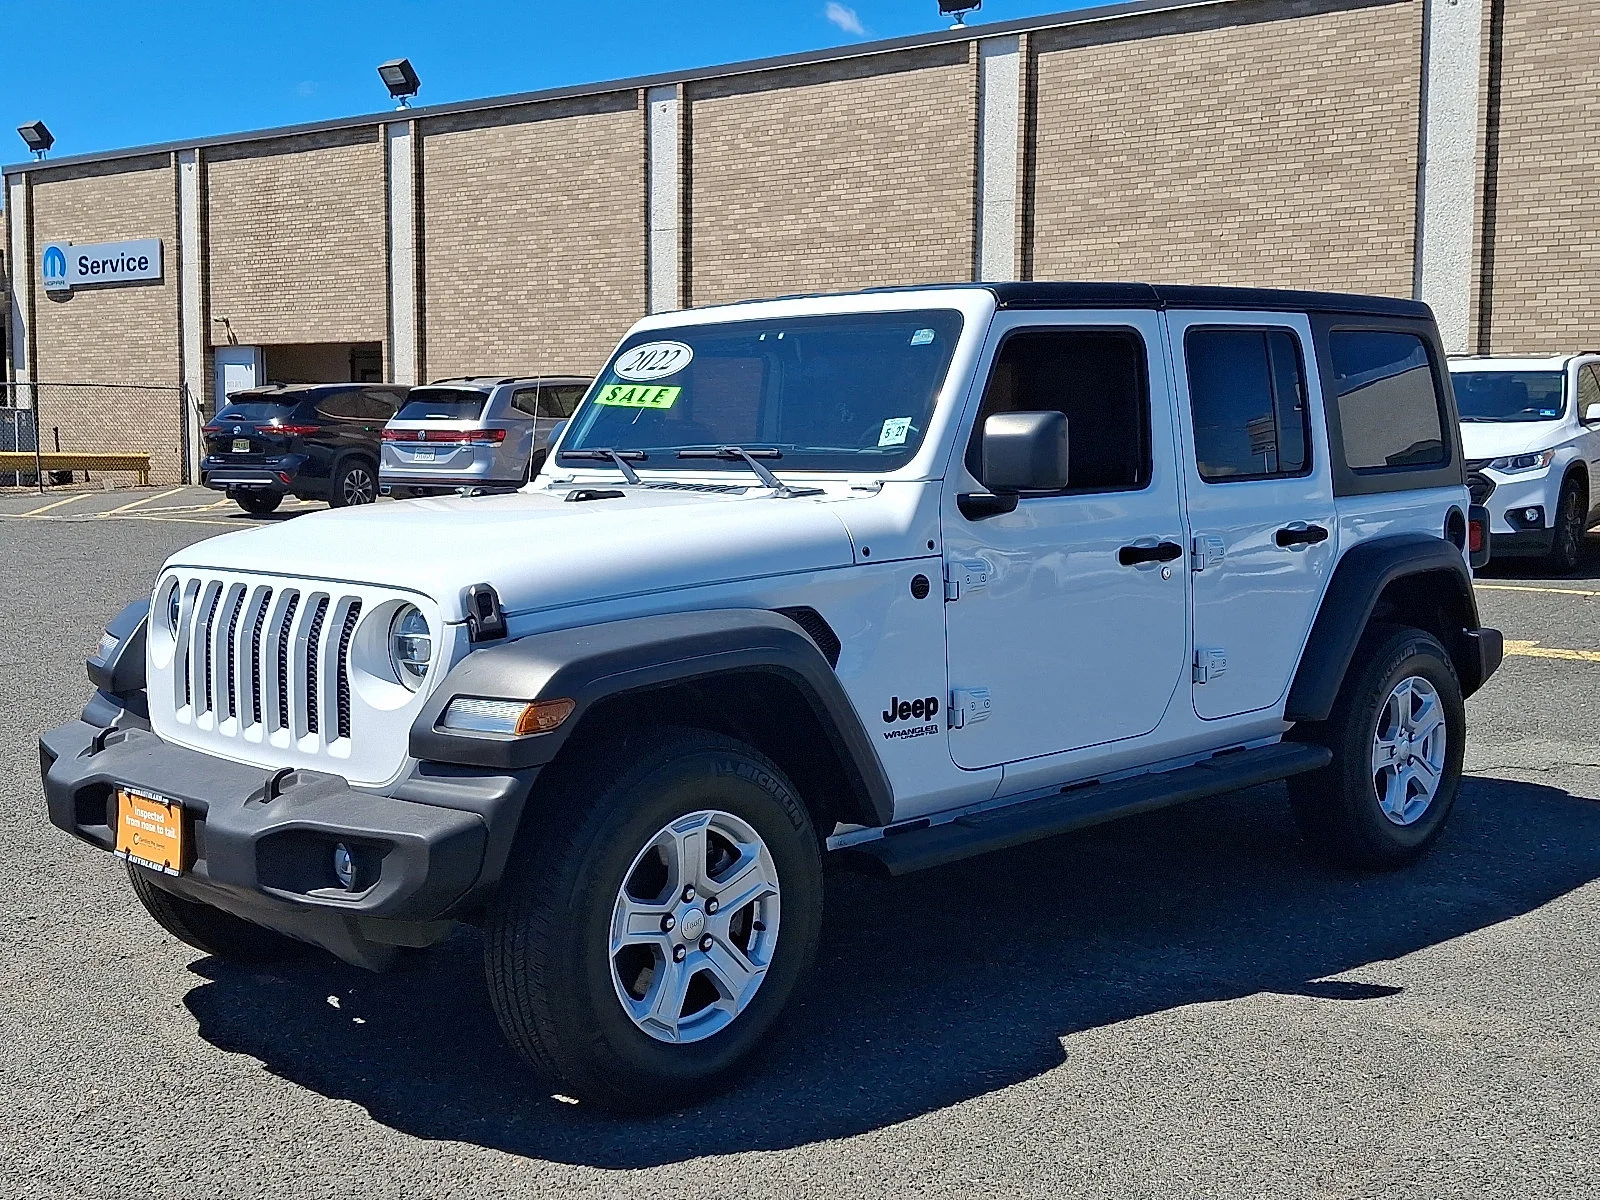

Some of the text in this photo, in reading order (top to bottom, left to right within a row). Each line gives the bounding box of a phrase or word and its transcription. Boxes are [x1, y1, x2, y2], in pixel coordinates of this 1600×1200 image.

[78, 252, 149, 275] Service
[623, 349, 682, 371] 2022
[605, 387, 670, 404] SALE
[885, 426, 905, 438] 5 27
[882, 695, 939, 723] Jeep
[884, 724, 939, 739] WRANGLER
[735, 762, 804, 829] MICHELIN
[134, 806, 164, 823] Inspected
[126, 815, 177, 838] from nose to tail.
